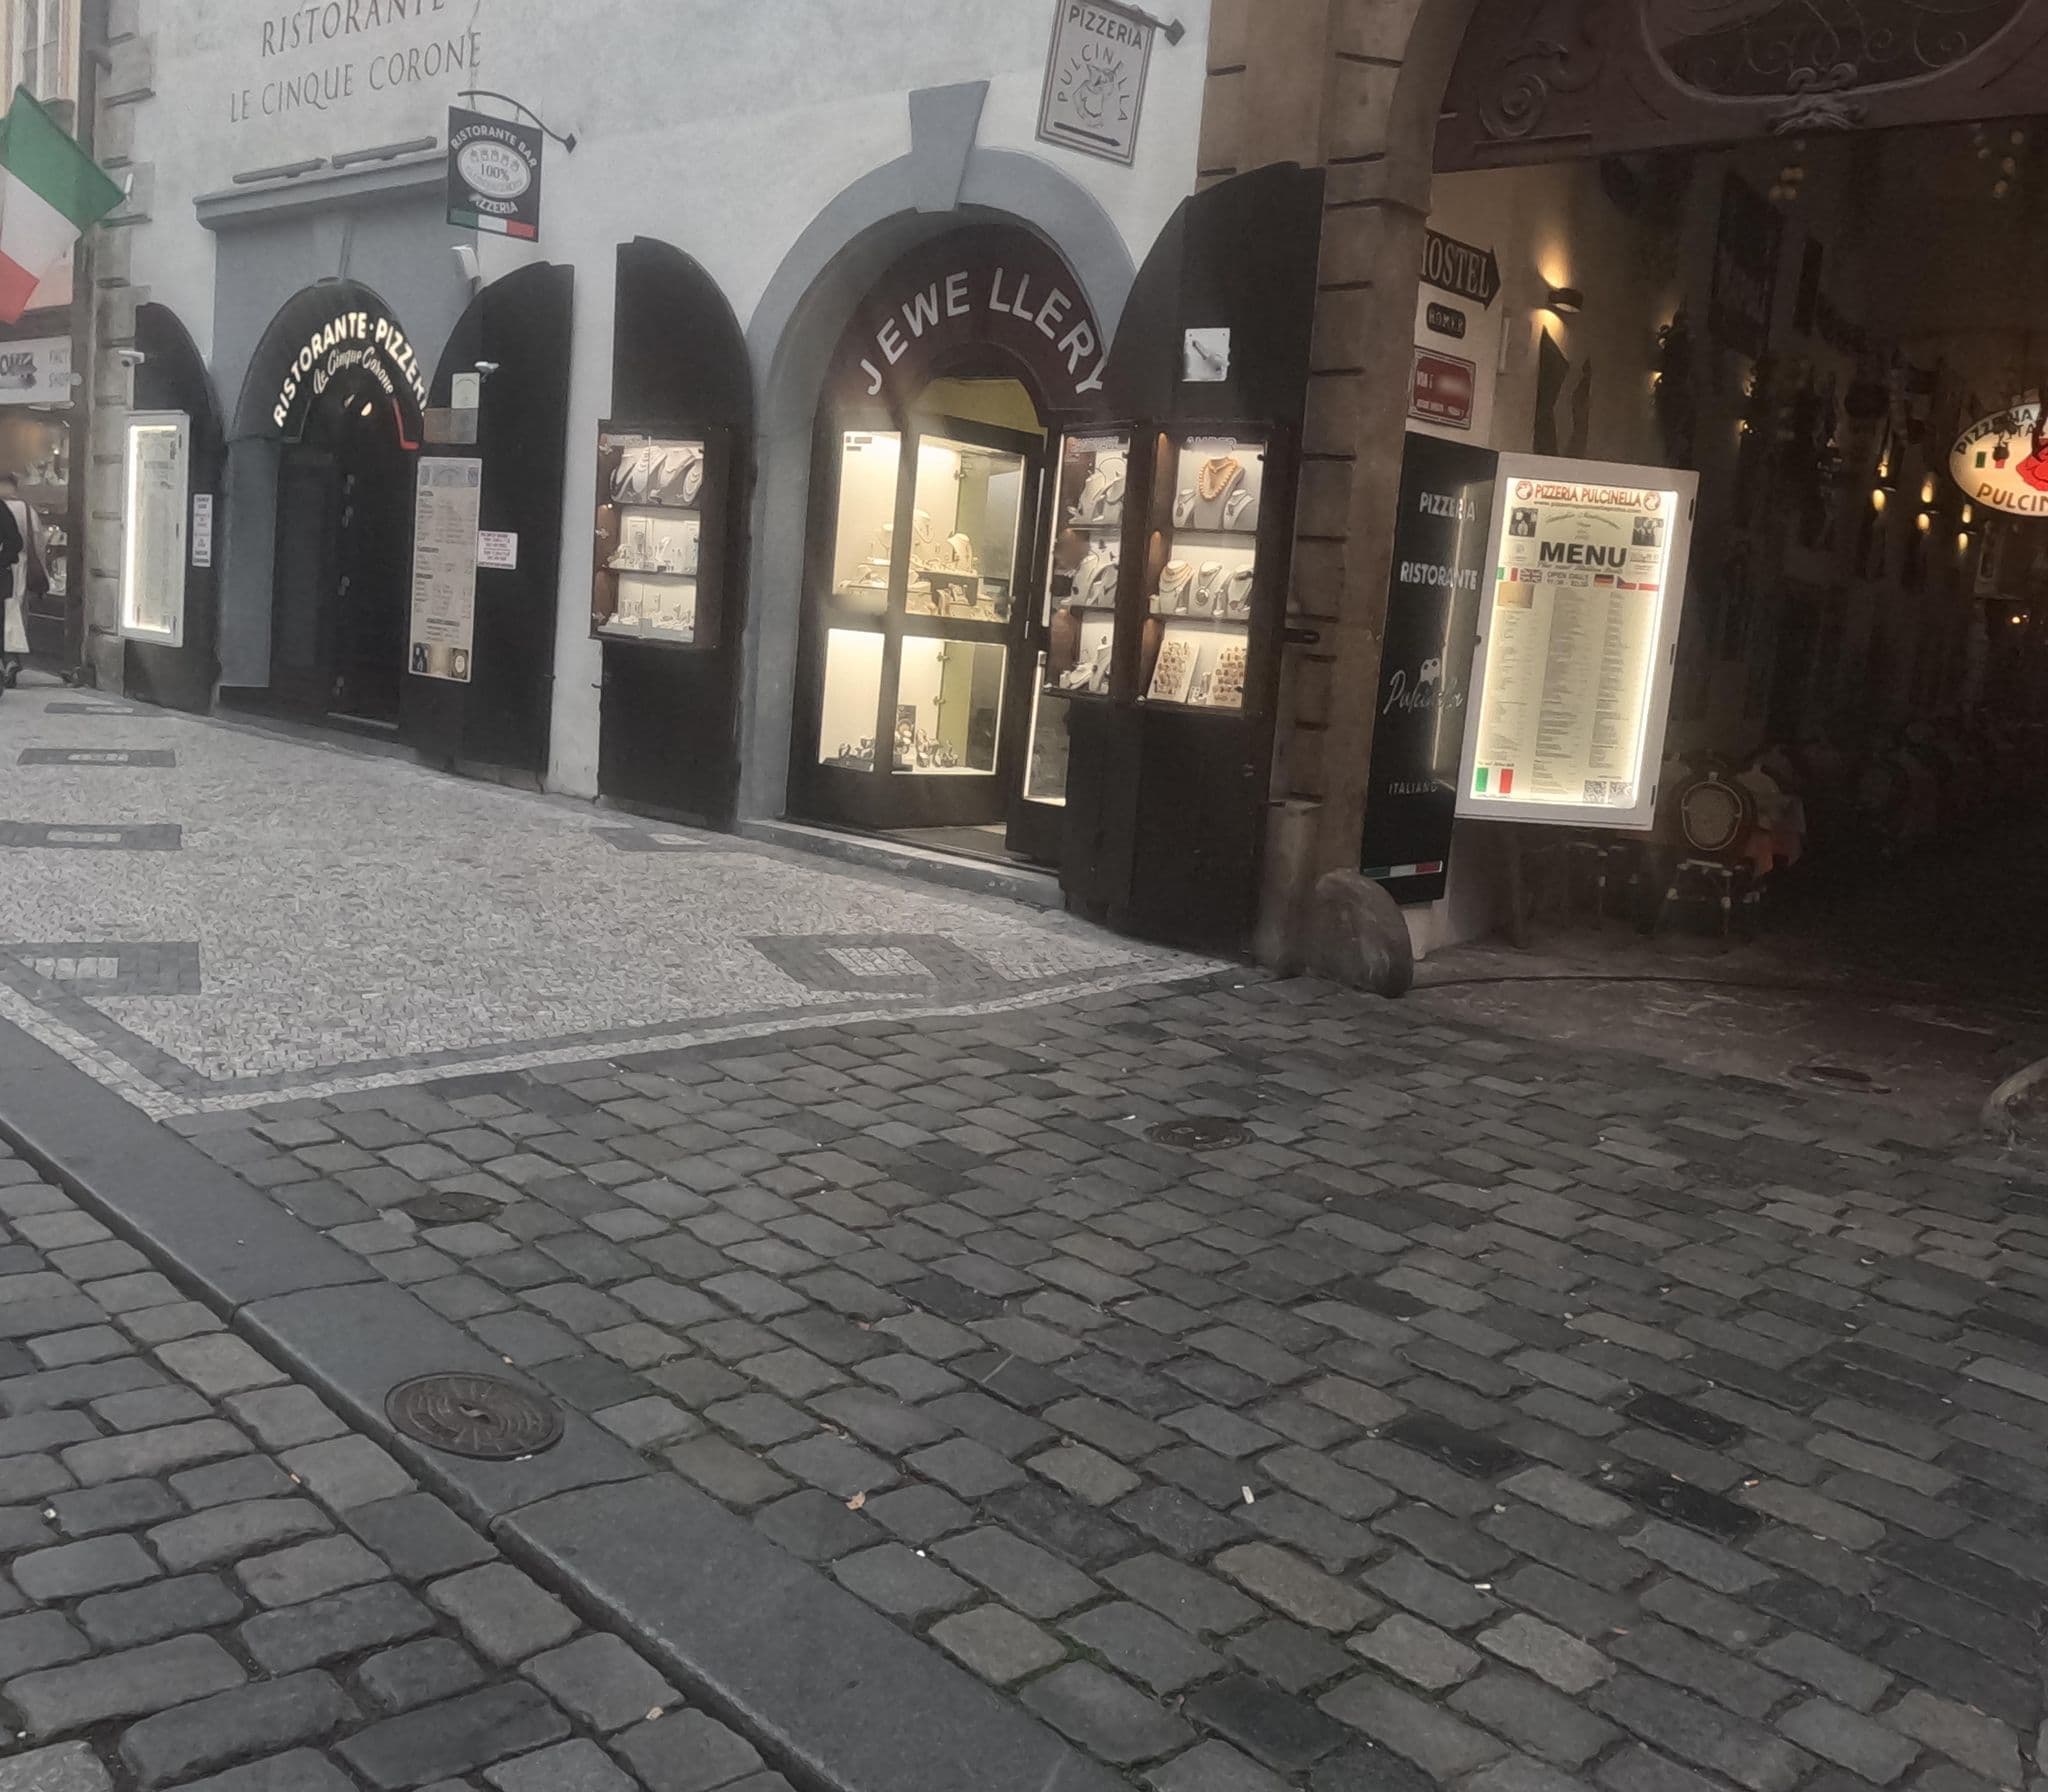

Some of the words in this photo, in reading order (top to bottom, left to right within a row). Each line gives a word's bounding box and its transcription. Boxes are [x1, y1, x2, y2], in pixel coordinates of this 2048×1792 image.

[1068, 5, 1142, 50] PIZZERIA
[231, 90, 250, 122] LE
[262, 64, 354, 114] CINQUE
[369, 32, 482, 90] CORONE
[450, 125, 518, 150] RISTORANTE
[518, 142, 538, 168] BAR
[273, 312, 368, 428] RISTORANTE
[328, 349, 362, 376] Cinque
[362, 346, 394, 394] Corone
[1419, 491, 1476, 521] PIZZERIA
[1535, 483, 1577, 502] PIZZERIA
[1582, 487, 1641, 507] PULCINELLA
[1400, 561, 1478, 591] RISTORANTE
[1539, 541, 1627, 569] MENU
